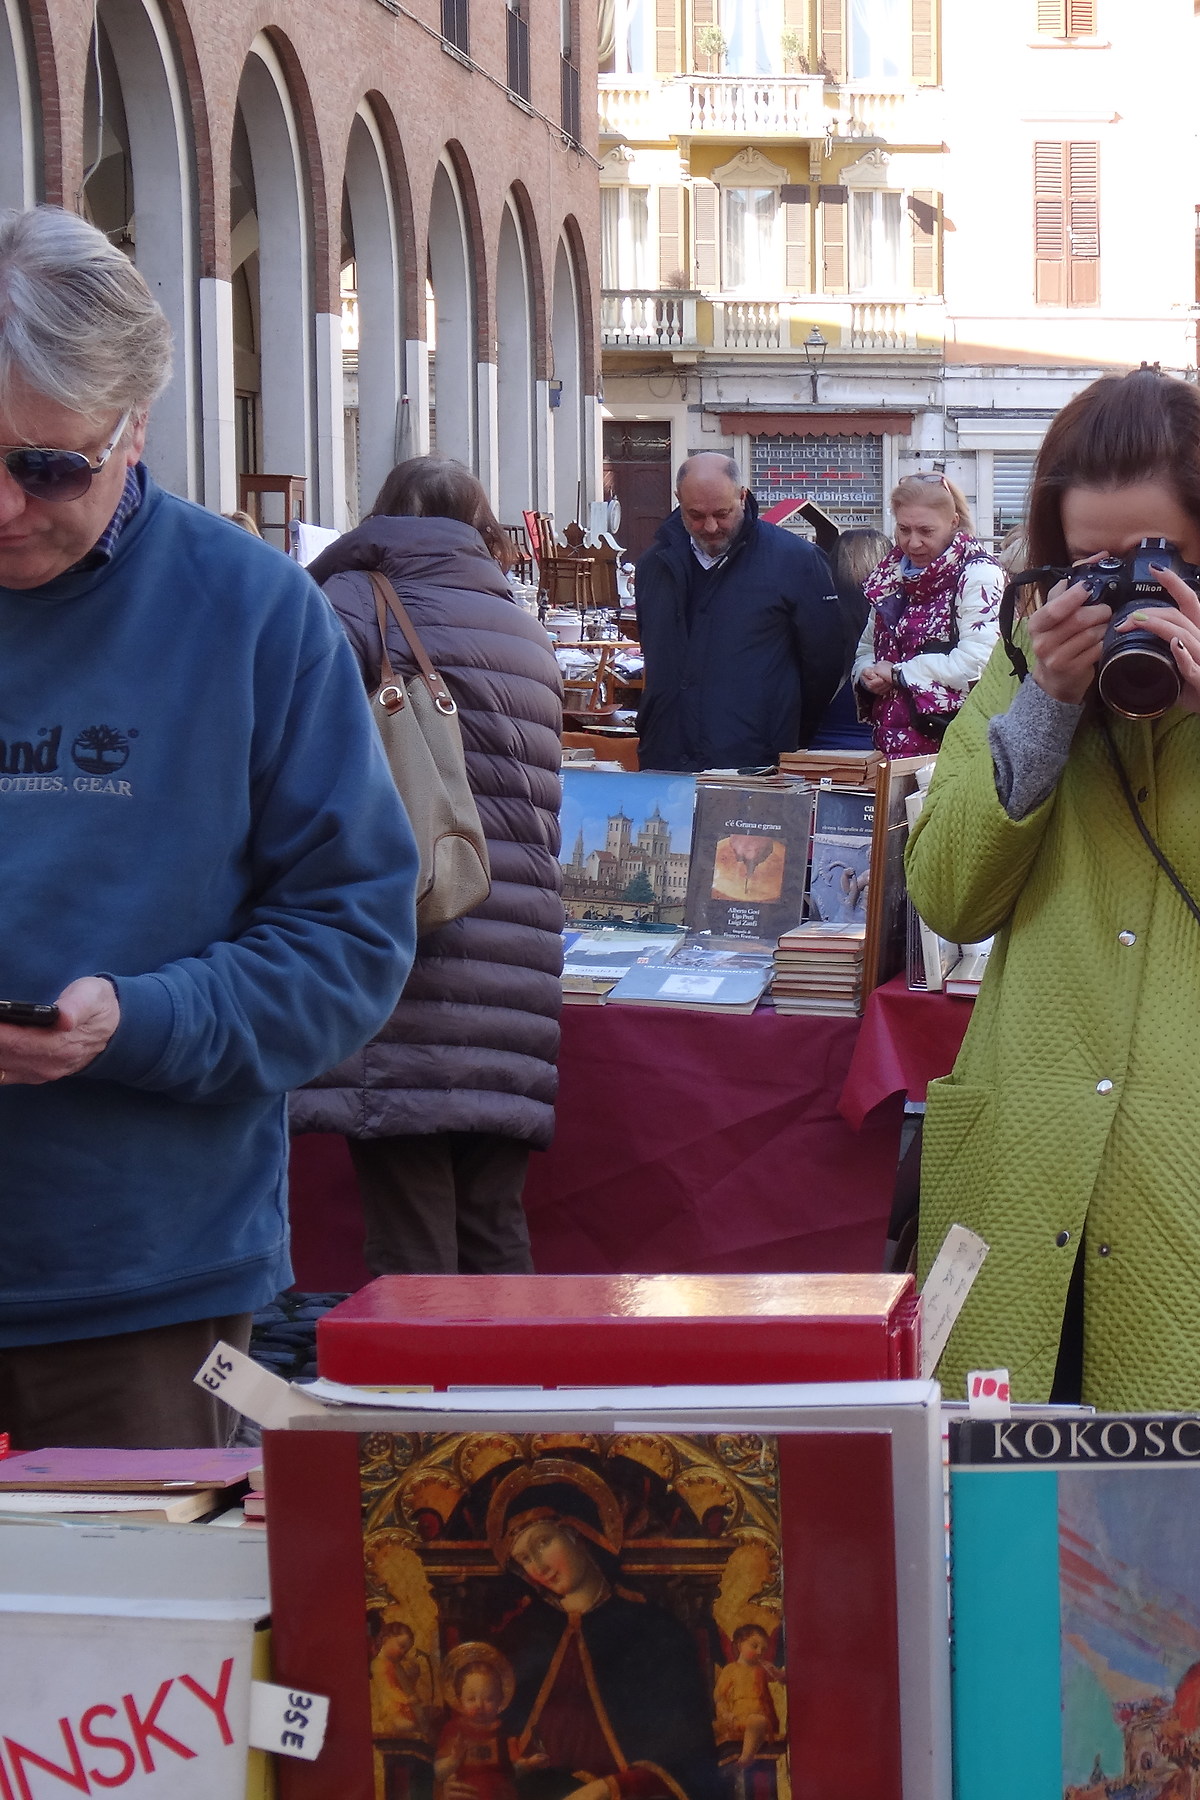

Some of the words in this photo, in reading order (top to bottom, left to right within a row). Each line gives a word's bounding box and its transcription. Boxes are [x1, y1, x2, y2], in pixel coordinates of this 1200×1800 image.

[757, 490, 804, 501] Helena
[806, 490, 875, 501] Rubinstein
[1135, 583, 1162, 592] Nikon
[73, 777, 133, 797] GEAR
